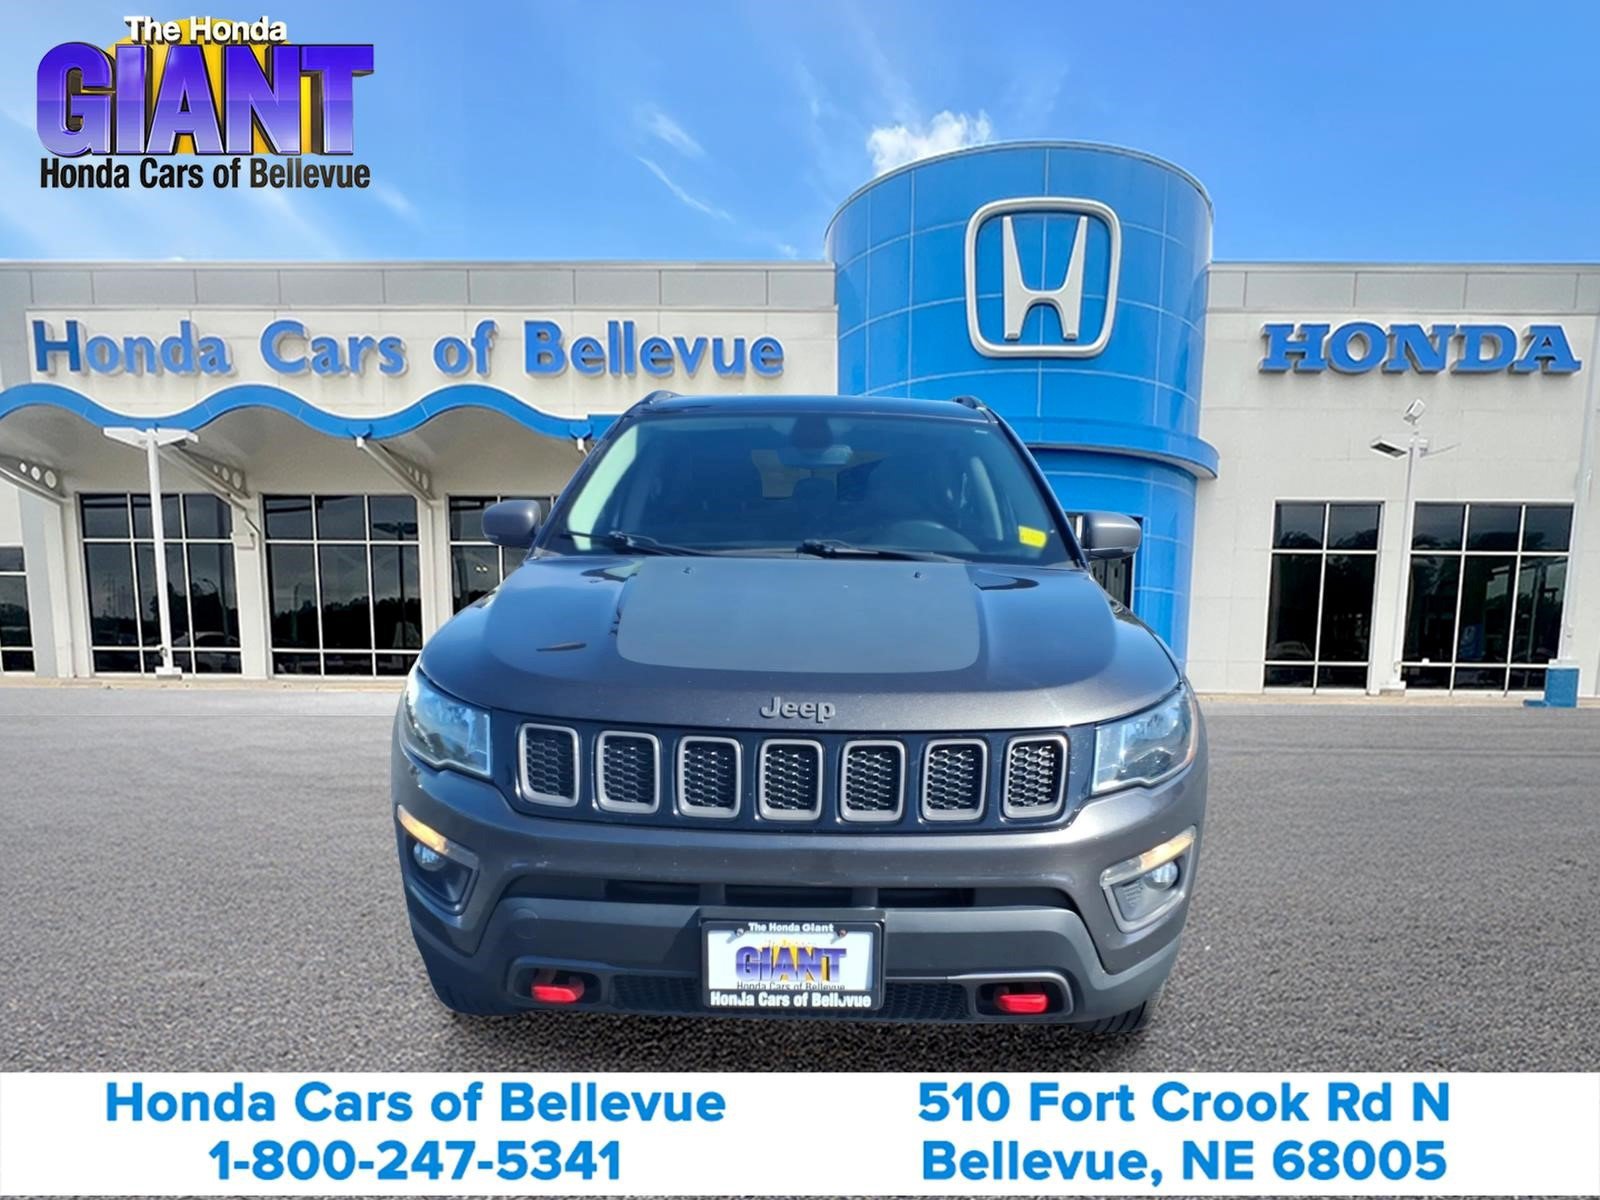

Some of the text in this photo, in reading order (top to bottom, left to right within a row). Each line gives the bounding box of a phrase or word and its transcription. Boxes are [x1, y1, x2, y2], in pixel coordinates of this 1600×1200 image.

[32, 319, 785, 378] Honda Cars of Bellevue
[1259, 322, 1582, 374] HONDA
[760, 696, 836, 724] Jeep
[748, 922, 834, 932] The Honda Giant
[735, 946, 847, 983] GIANT
[758, 991, 790, 1007] Cars
[793, 992, 809, 1007] of
